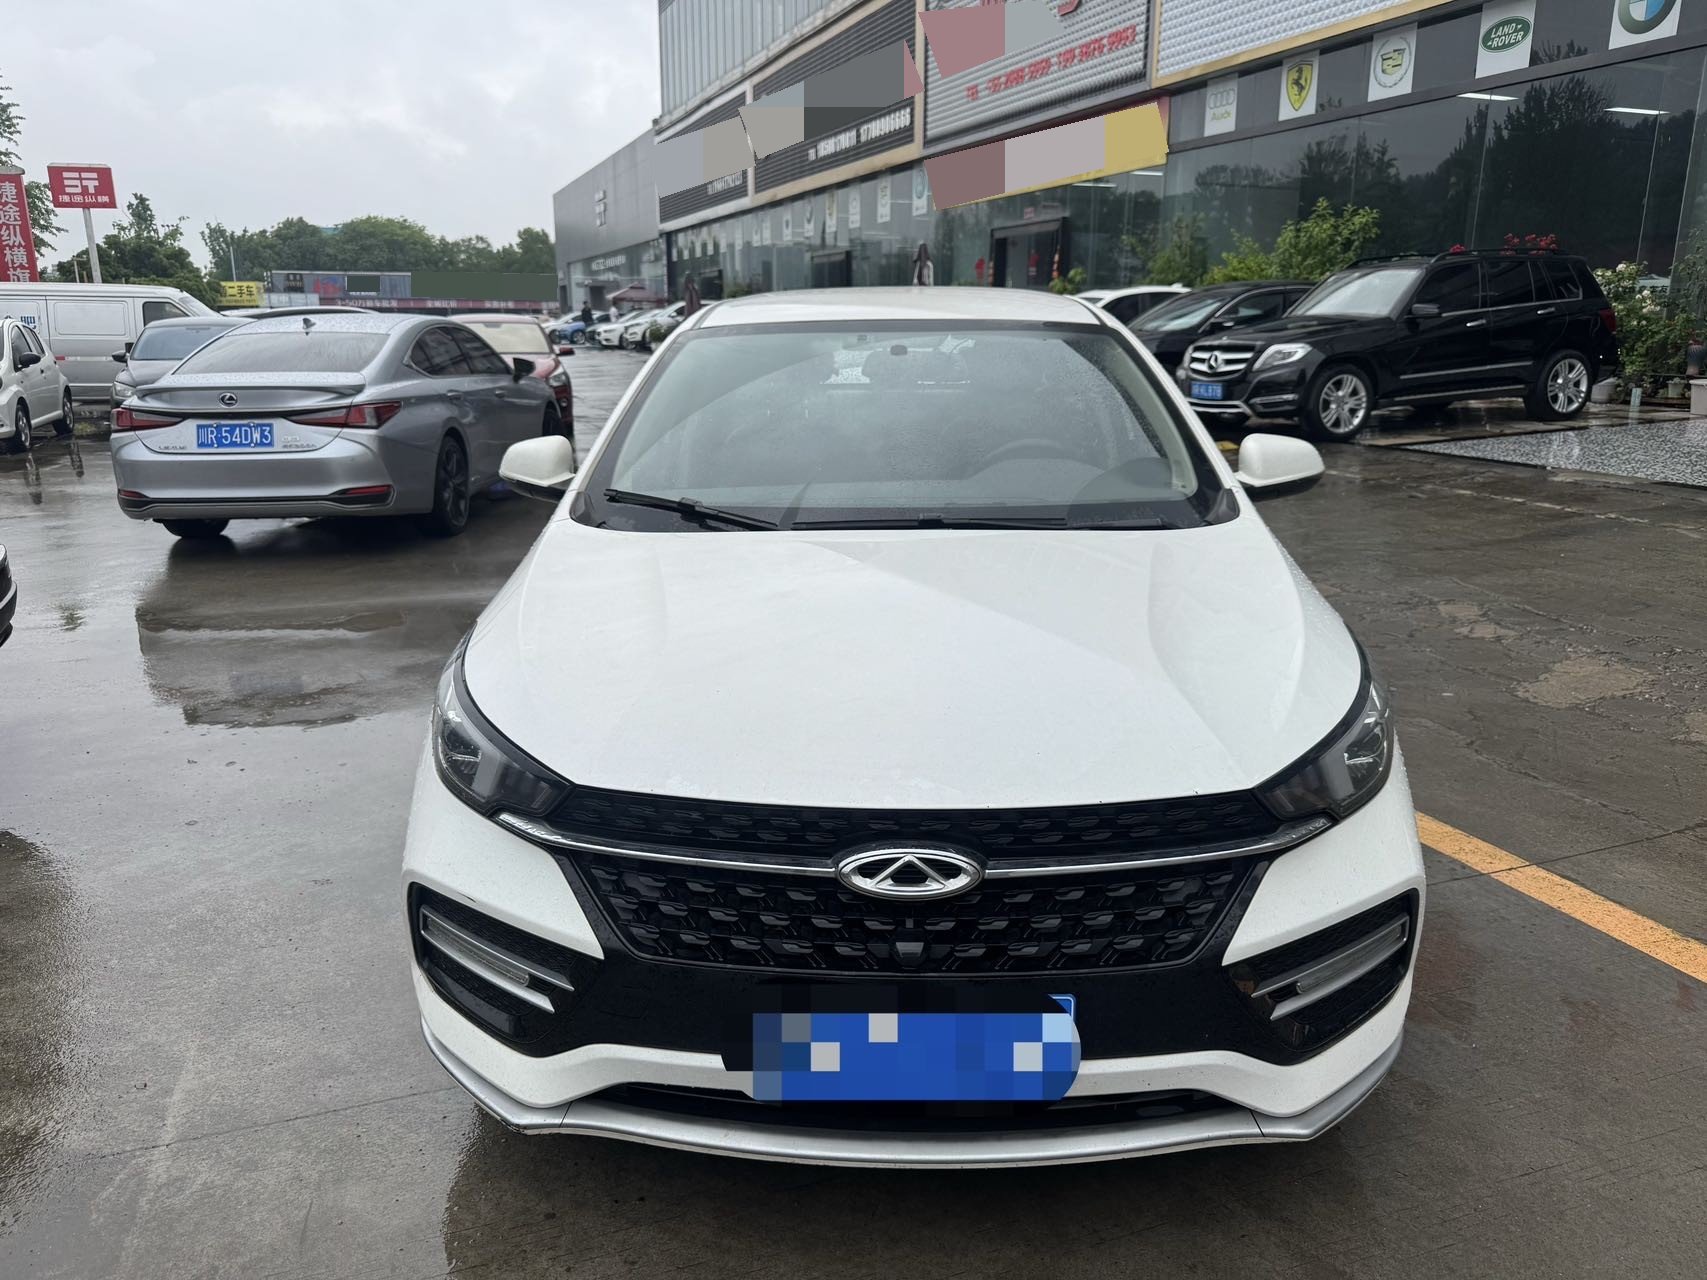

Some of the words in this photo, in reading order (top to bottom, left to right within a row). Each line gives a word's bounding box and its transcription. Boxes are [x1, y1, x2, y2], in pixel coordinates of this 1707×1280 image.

[1491, 24, 1516, 38] LAND
[1491, 31, 1524, 48] ROVER
[1210, 111, 1232, 122] Audi
[59, 195, 109, 203] 捷途纵横
